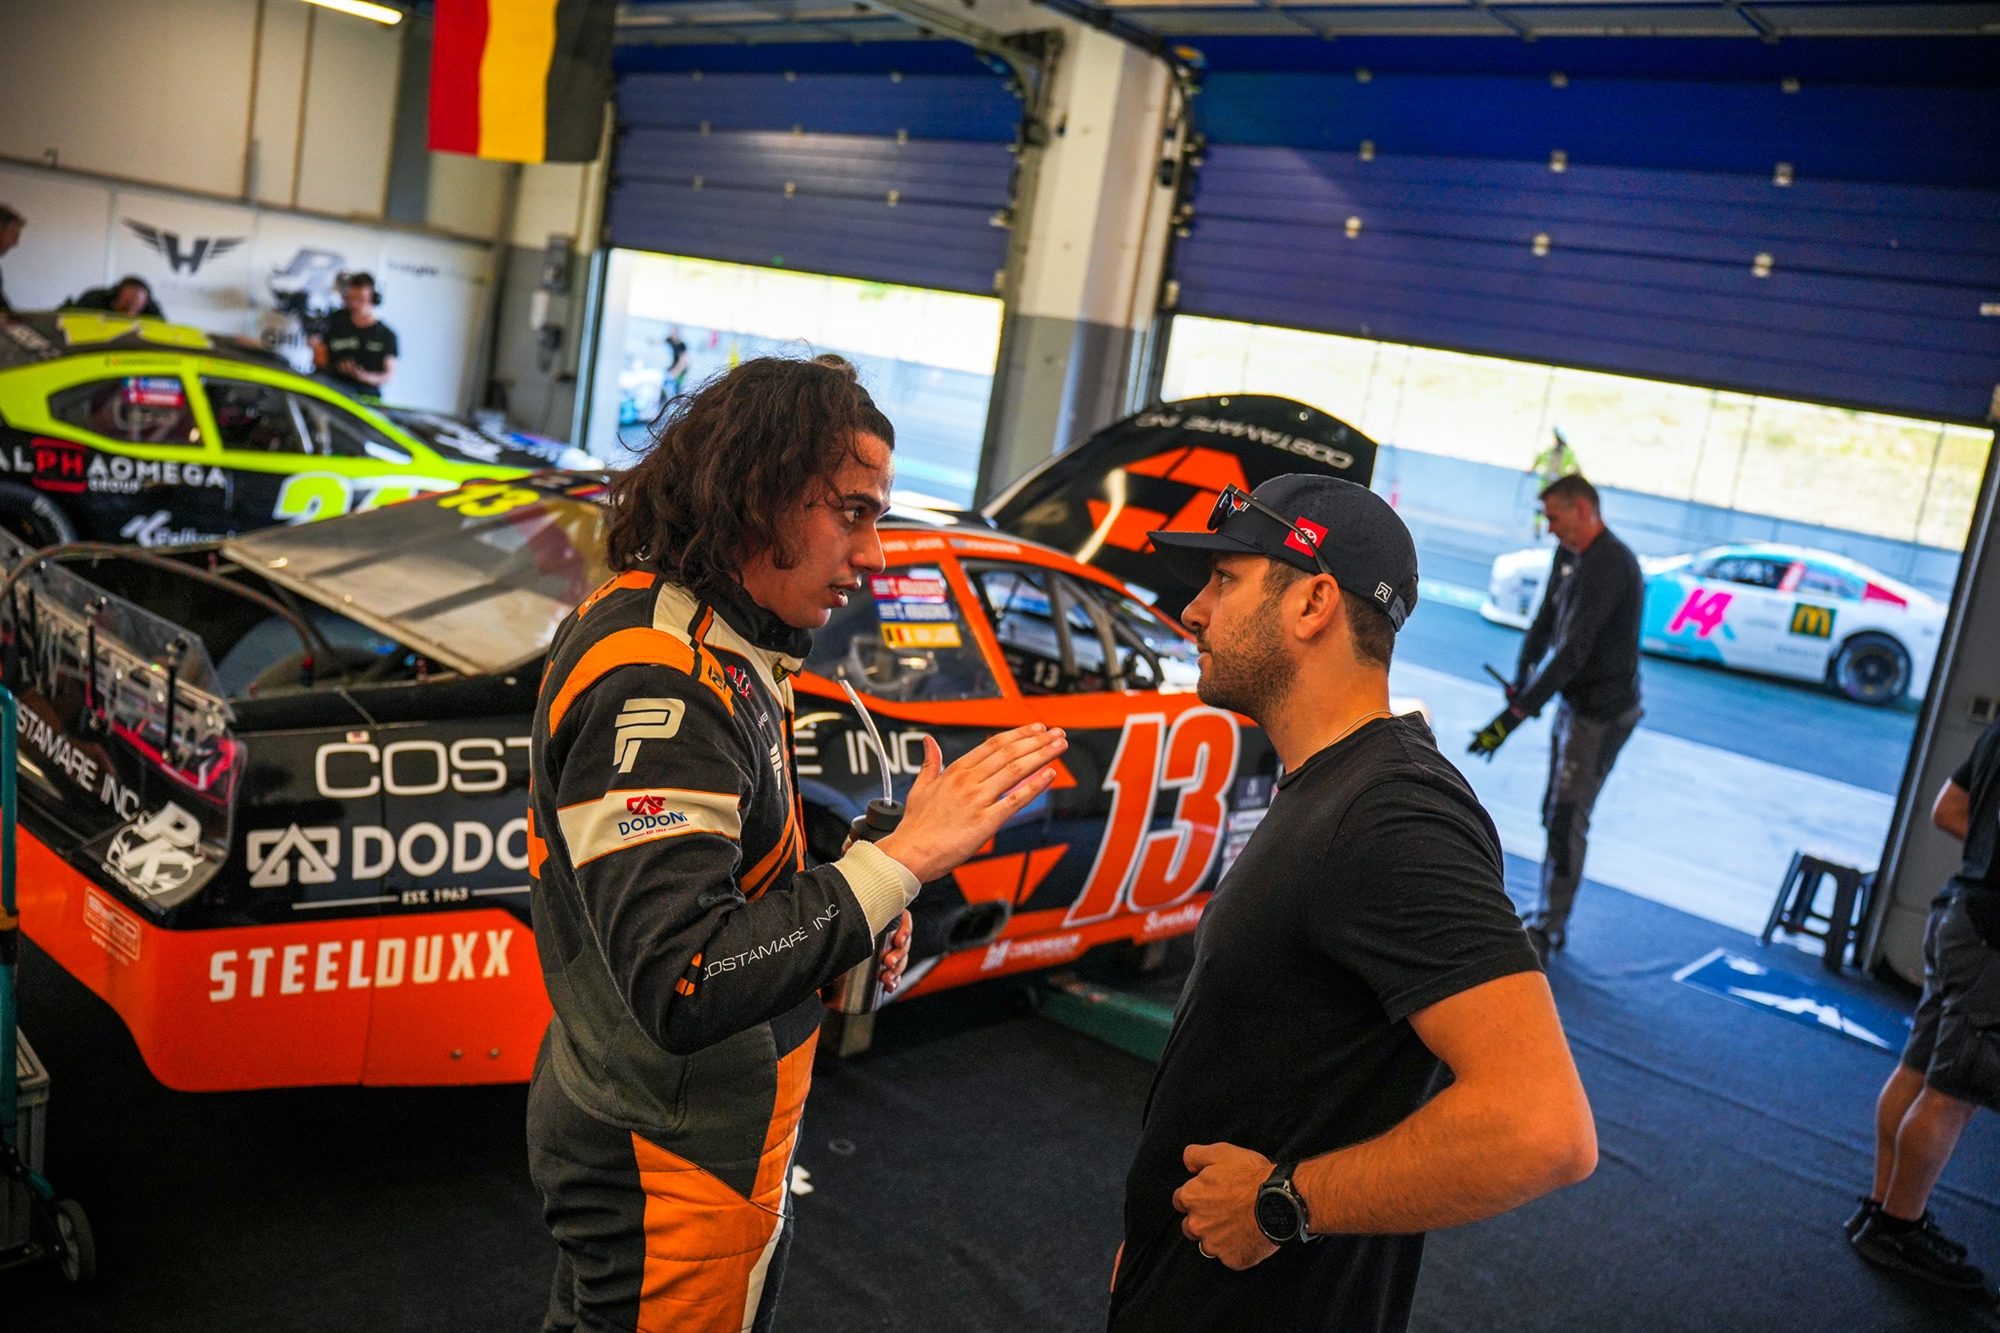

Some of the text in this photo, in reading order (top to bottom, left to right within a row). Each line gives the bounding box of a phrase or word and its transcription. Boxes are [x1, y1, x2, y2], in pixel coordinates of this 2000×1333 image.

[437, 484, 541, 518] 13
[16, 700, 98, 792] STAMARE
[1062, 706, 1241, 928] 13
[209, 929, 513, 1003] STEELDUXX
